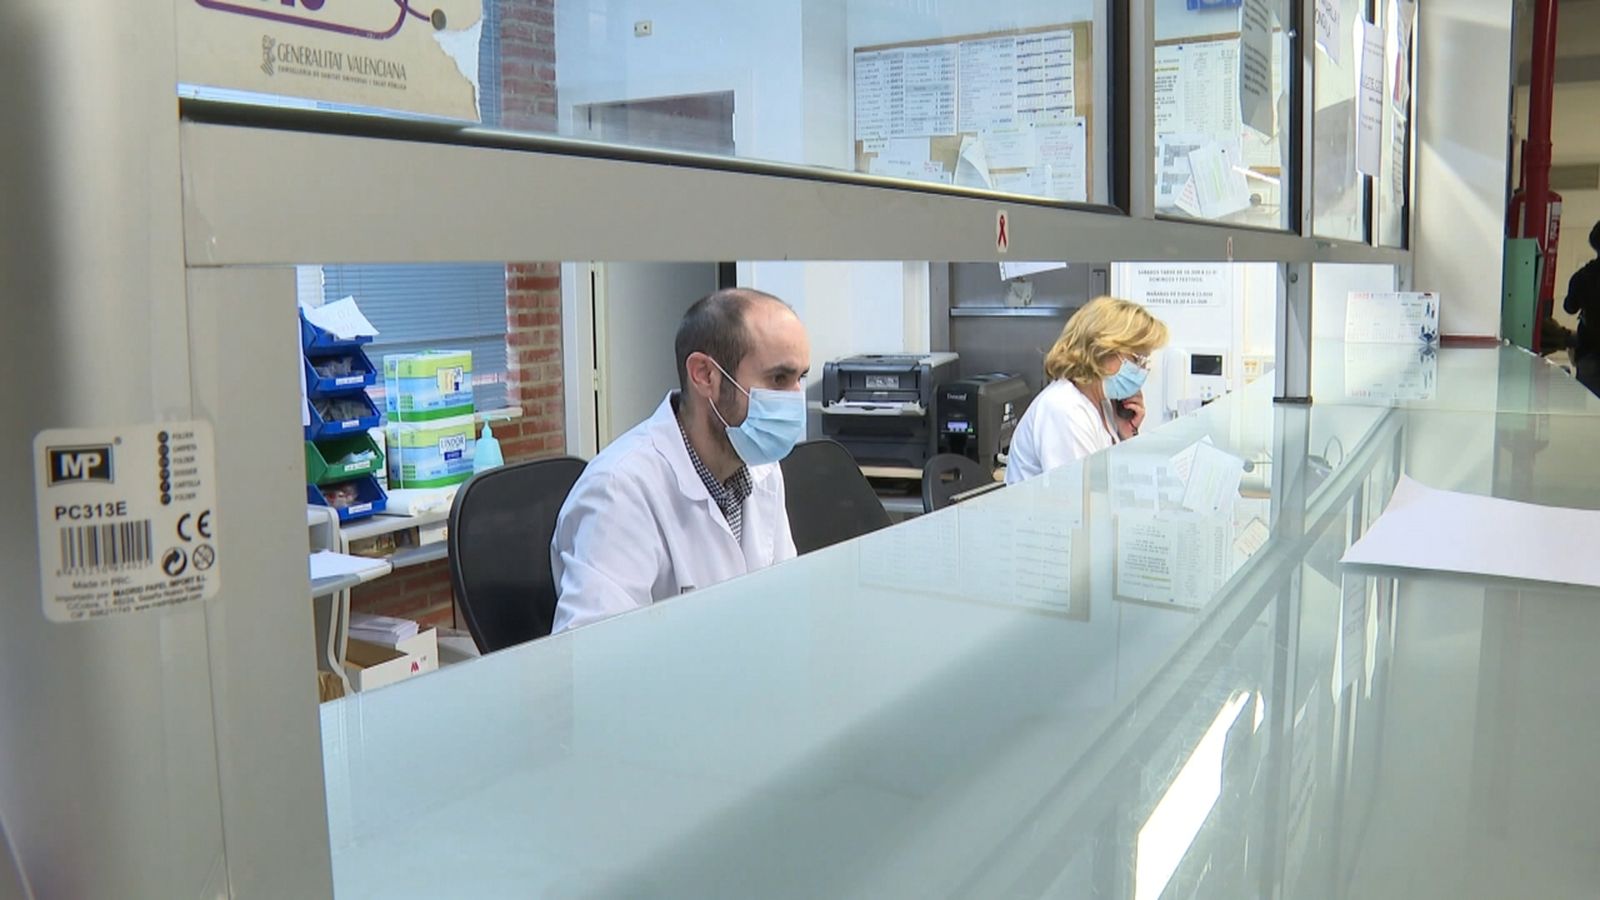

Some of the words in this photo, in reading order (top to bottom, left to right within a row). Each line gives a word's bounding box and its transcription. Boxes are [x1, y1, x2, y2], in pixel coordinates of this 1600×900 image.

[277, 43, 342, 71] GENERALITAT
[346, 54, 407, 81] VALENCIANA
[440, 436, 465, 450] LINDOR
[61, 452, 102, 481] MP
[55, 501, 127, 520] PC313E
[72, 580, 99, 590] Made
[113, 586, 144, 597] MADRID
[146, 581, 167, 593] PAPEL
